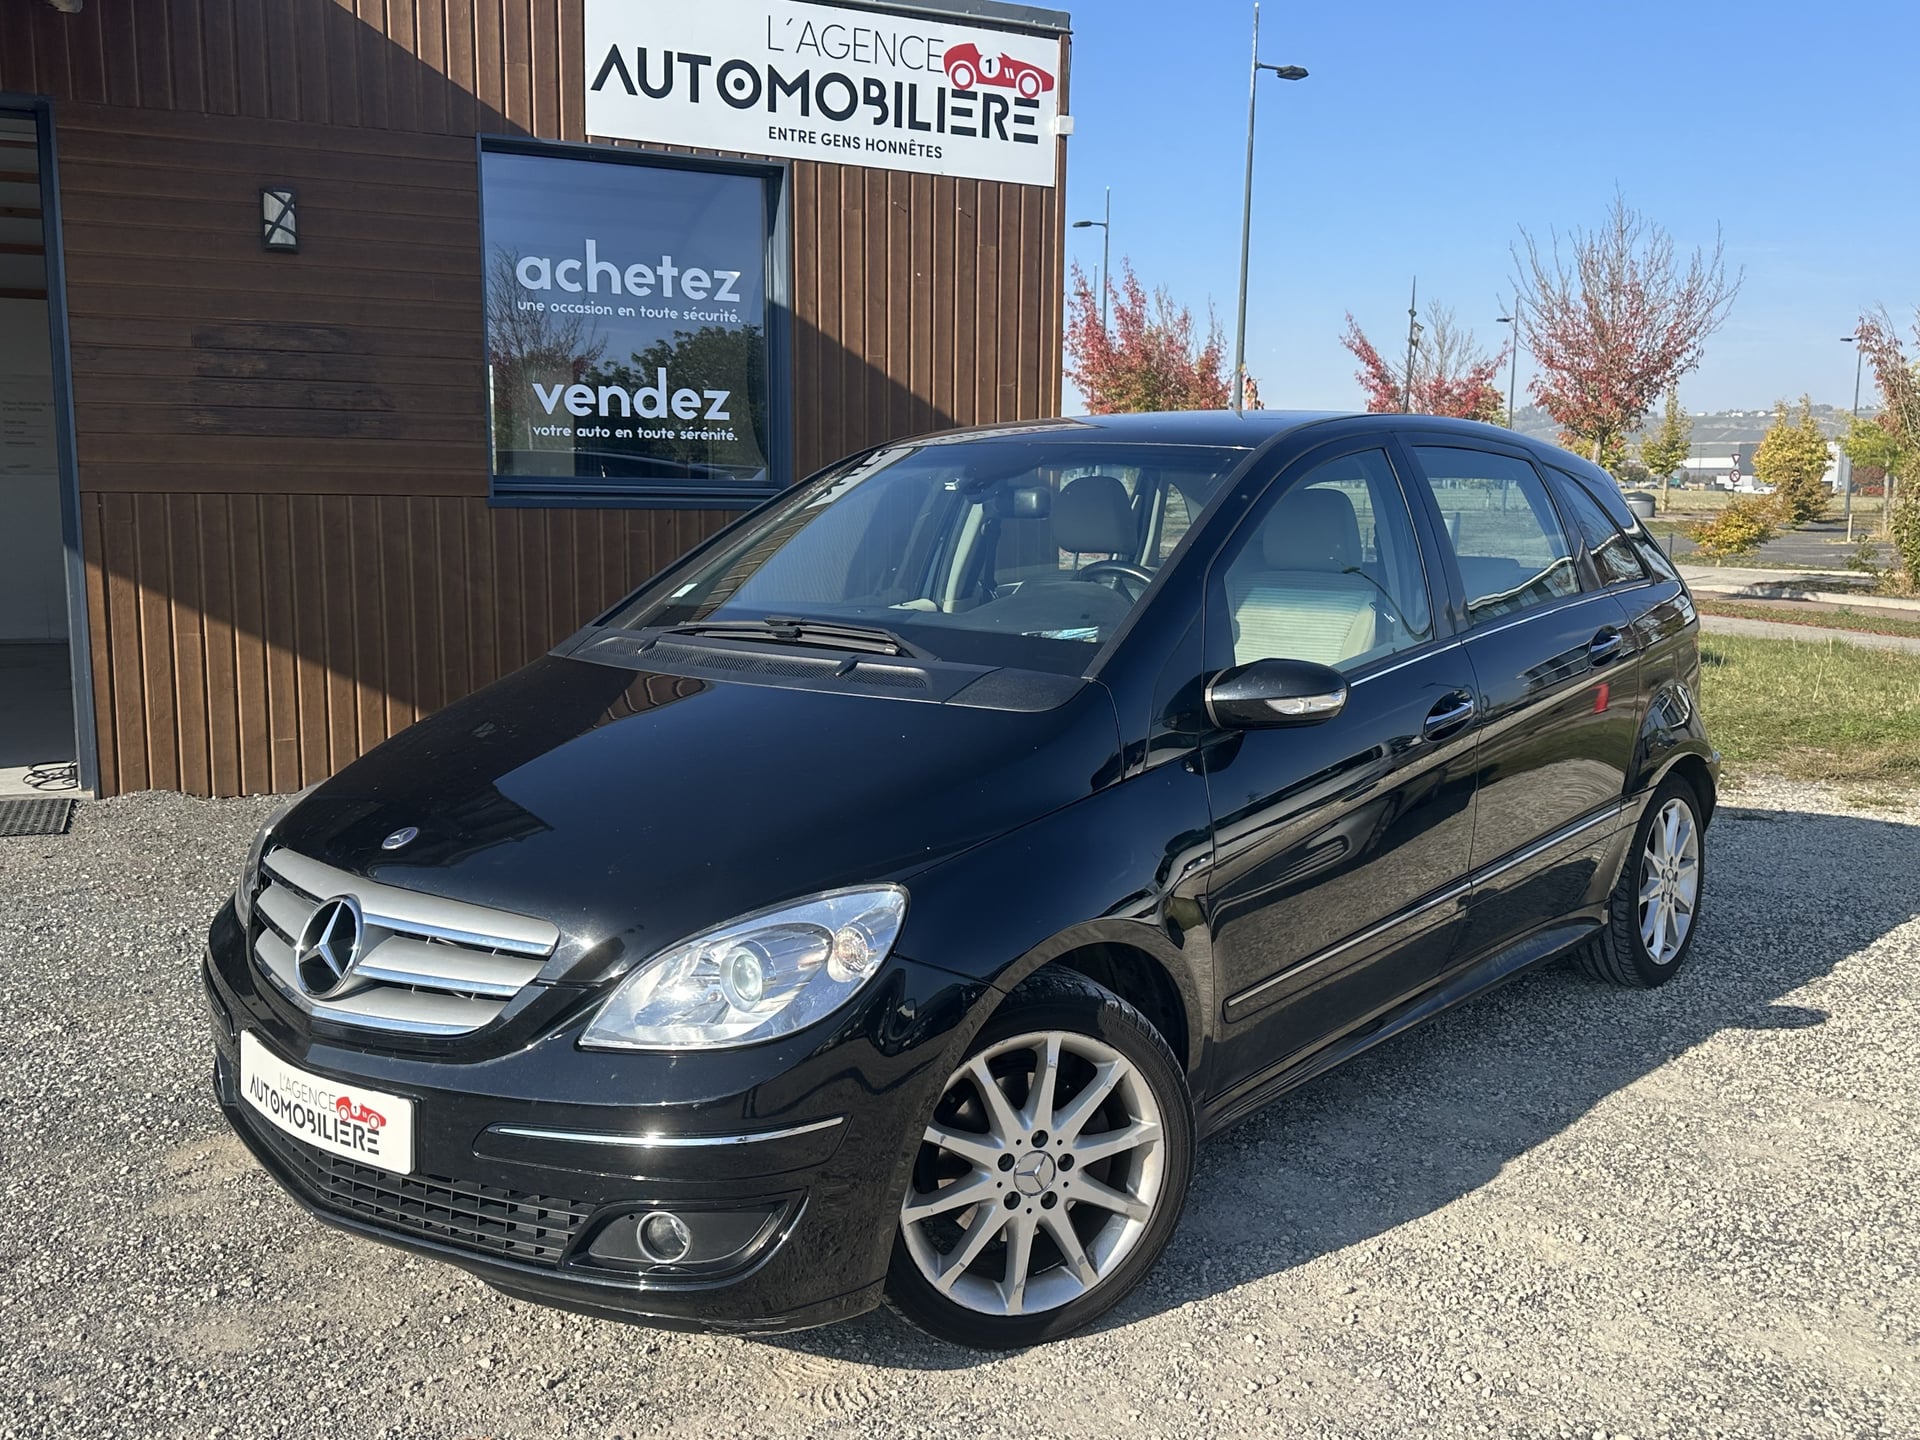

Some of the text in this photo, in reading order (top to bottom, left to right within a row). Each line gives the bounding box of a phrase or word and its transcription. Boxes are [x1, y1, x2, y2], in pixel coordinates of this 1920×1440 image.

[984, 58, 993, 74] 1
[768, 126, 943, 160] ENTRE GENS HONNÊTES
[515, 239, 741, 302] achetez
[517, 301, 741, 323] une occasion en toute sécurité.
[532, 367, 731, 421] vendez
[533, 425, 738, 442] votre auto en toute sérénité.
[279, 1072, 336, 1112] L'AGENCE
